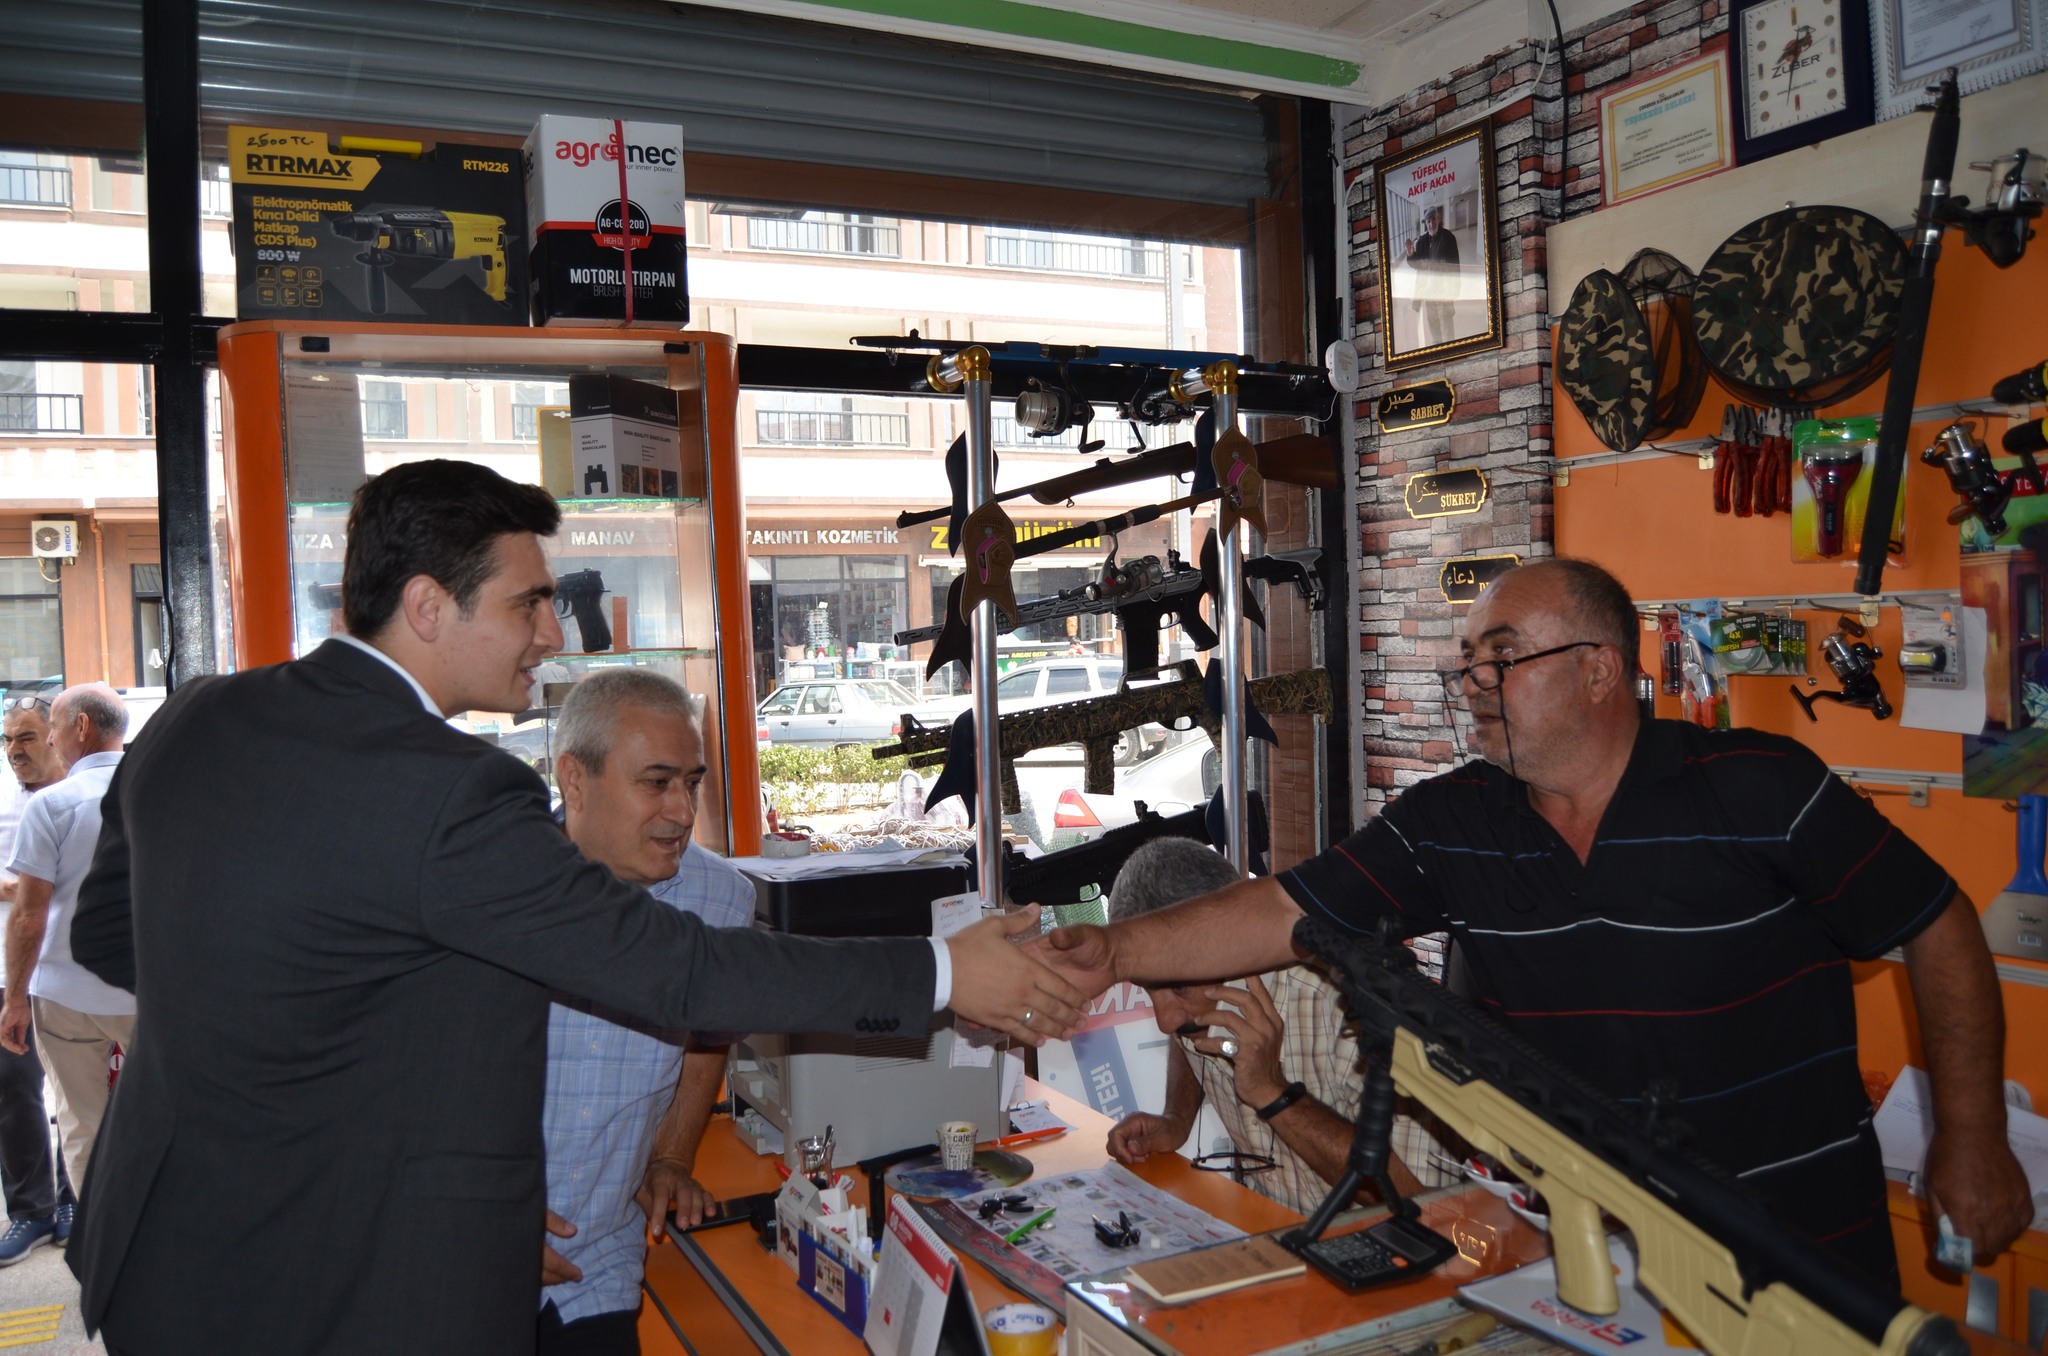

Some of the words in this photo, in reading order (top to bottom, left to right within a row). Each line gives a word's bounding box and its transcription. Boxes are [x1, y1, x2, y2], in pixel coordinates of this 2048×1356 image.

[1771, 54, 1820, 79] ZUBER
[246, 153, 353, 177] RTRMAX
[463, 159, 509, 173] RTM226
[635, 163, 652, 171] inner
[1411, 157, 1447, 182] TÜFEKÇİ
[1407, 181, 1428, 198] AKİF
[1429, 172, 1456, 192] AKAN
[253, 196, 353, 213] Elektropnömatik
[286, 211, 320, 223] Delici
[600, 218, 645, 229] AG-C20D
[254, 221, 299, 235] Matkap
[254, 234, 286, 246] (SDS
[287, 235, 317, 249] Plus)
[603, 236, 616, 245] HIGH
[617, 237, 641, 246] QUITY
[257, 249, 285, 261] 800
[286, 250, 301, 262] W
[631, 270, 676, 287] TIRPAN
[593, 285, 620, 297] BRUSH
[623, 286, 653, 299] CTTER
[1382, 391, 1415, 414] صبر
[1410, 403, 1444, 421] SABRET
[1414, 481, 1439, 503] شكرا
[1440, 491, 1477, 512] ŞÜKRET
[64, 525, 72, 552] BEKO
[570, 531, 635, 546] MANAV
[746, 529, 809, 545] TAKINTI
[817, 525, 899, 545] KOZMETİK
[1729, 631, 1741, 640] 4X
